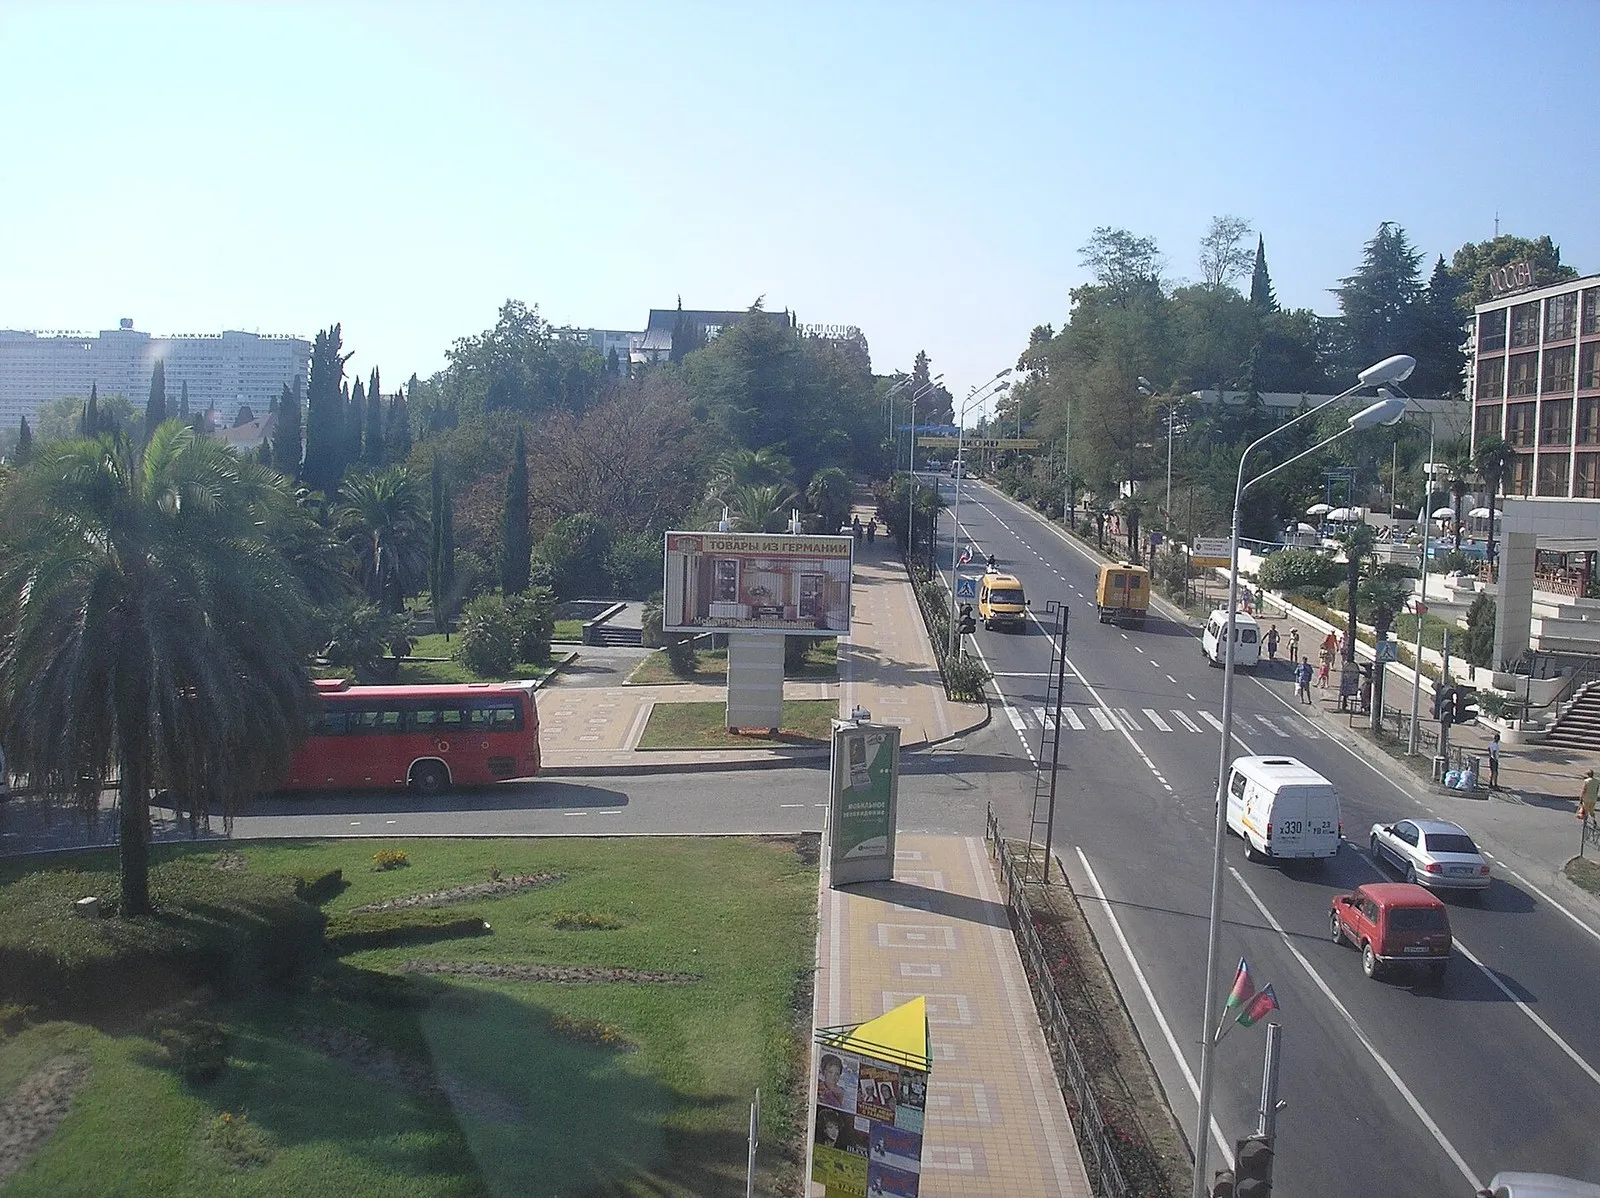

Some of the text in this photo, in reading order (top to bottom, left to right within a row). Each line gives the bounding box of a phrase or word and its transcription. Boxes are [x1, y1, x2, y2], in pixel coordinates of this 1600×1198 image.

[710, 541, 848, 553] ТОВАРЫ ИЗ ГЕРМАНИИ
